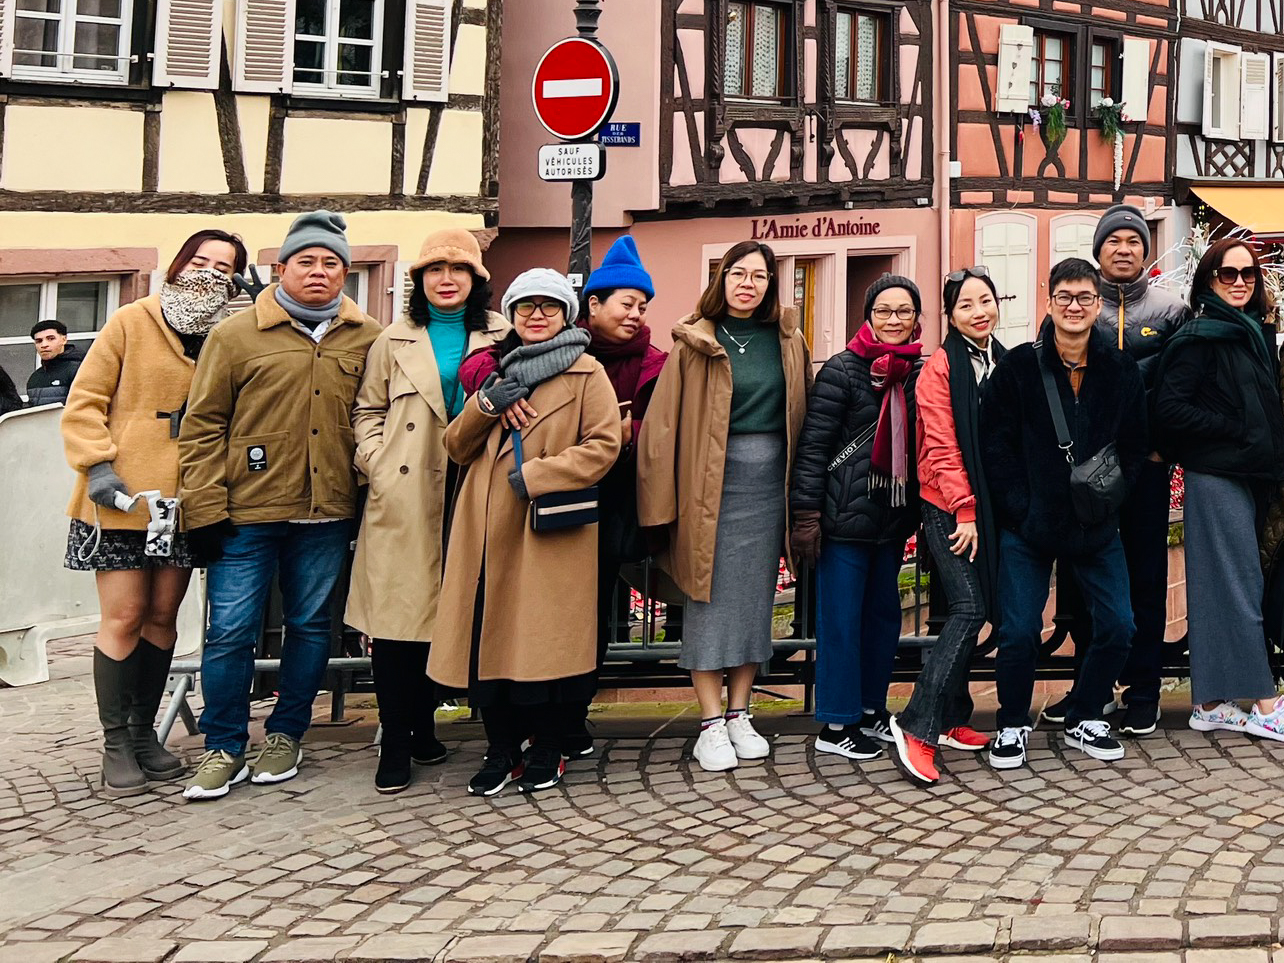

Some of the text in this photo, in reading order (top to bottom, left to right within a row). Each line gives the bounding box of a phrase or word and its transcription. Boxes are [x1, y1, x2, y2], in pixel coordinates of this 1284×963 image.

[558, 147, 580, 156] SAUF
[545, 157, 593, 166] VÉHICULES
[545, 166, 593, 176] AUTORISÉS
[827, 442, 858, 471] CHEVIOT
